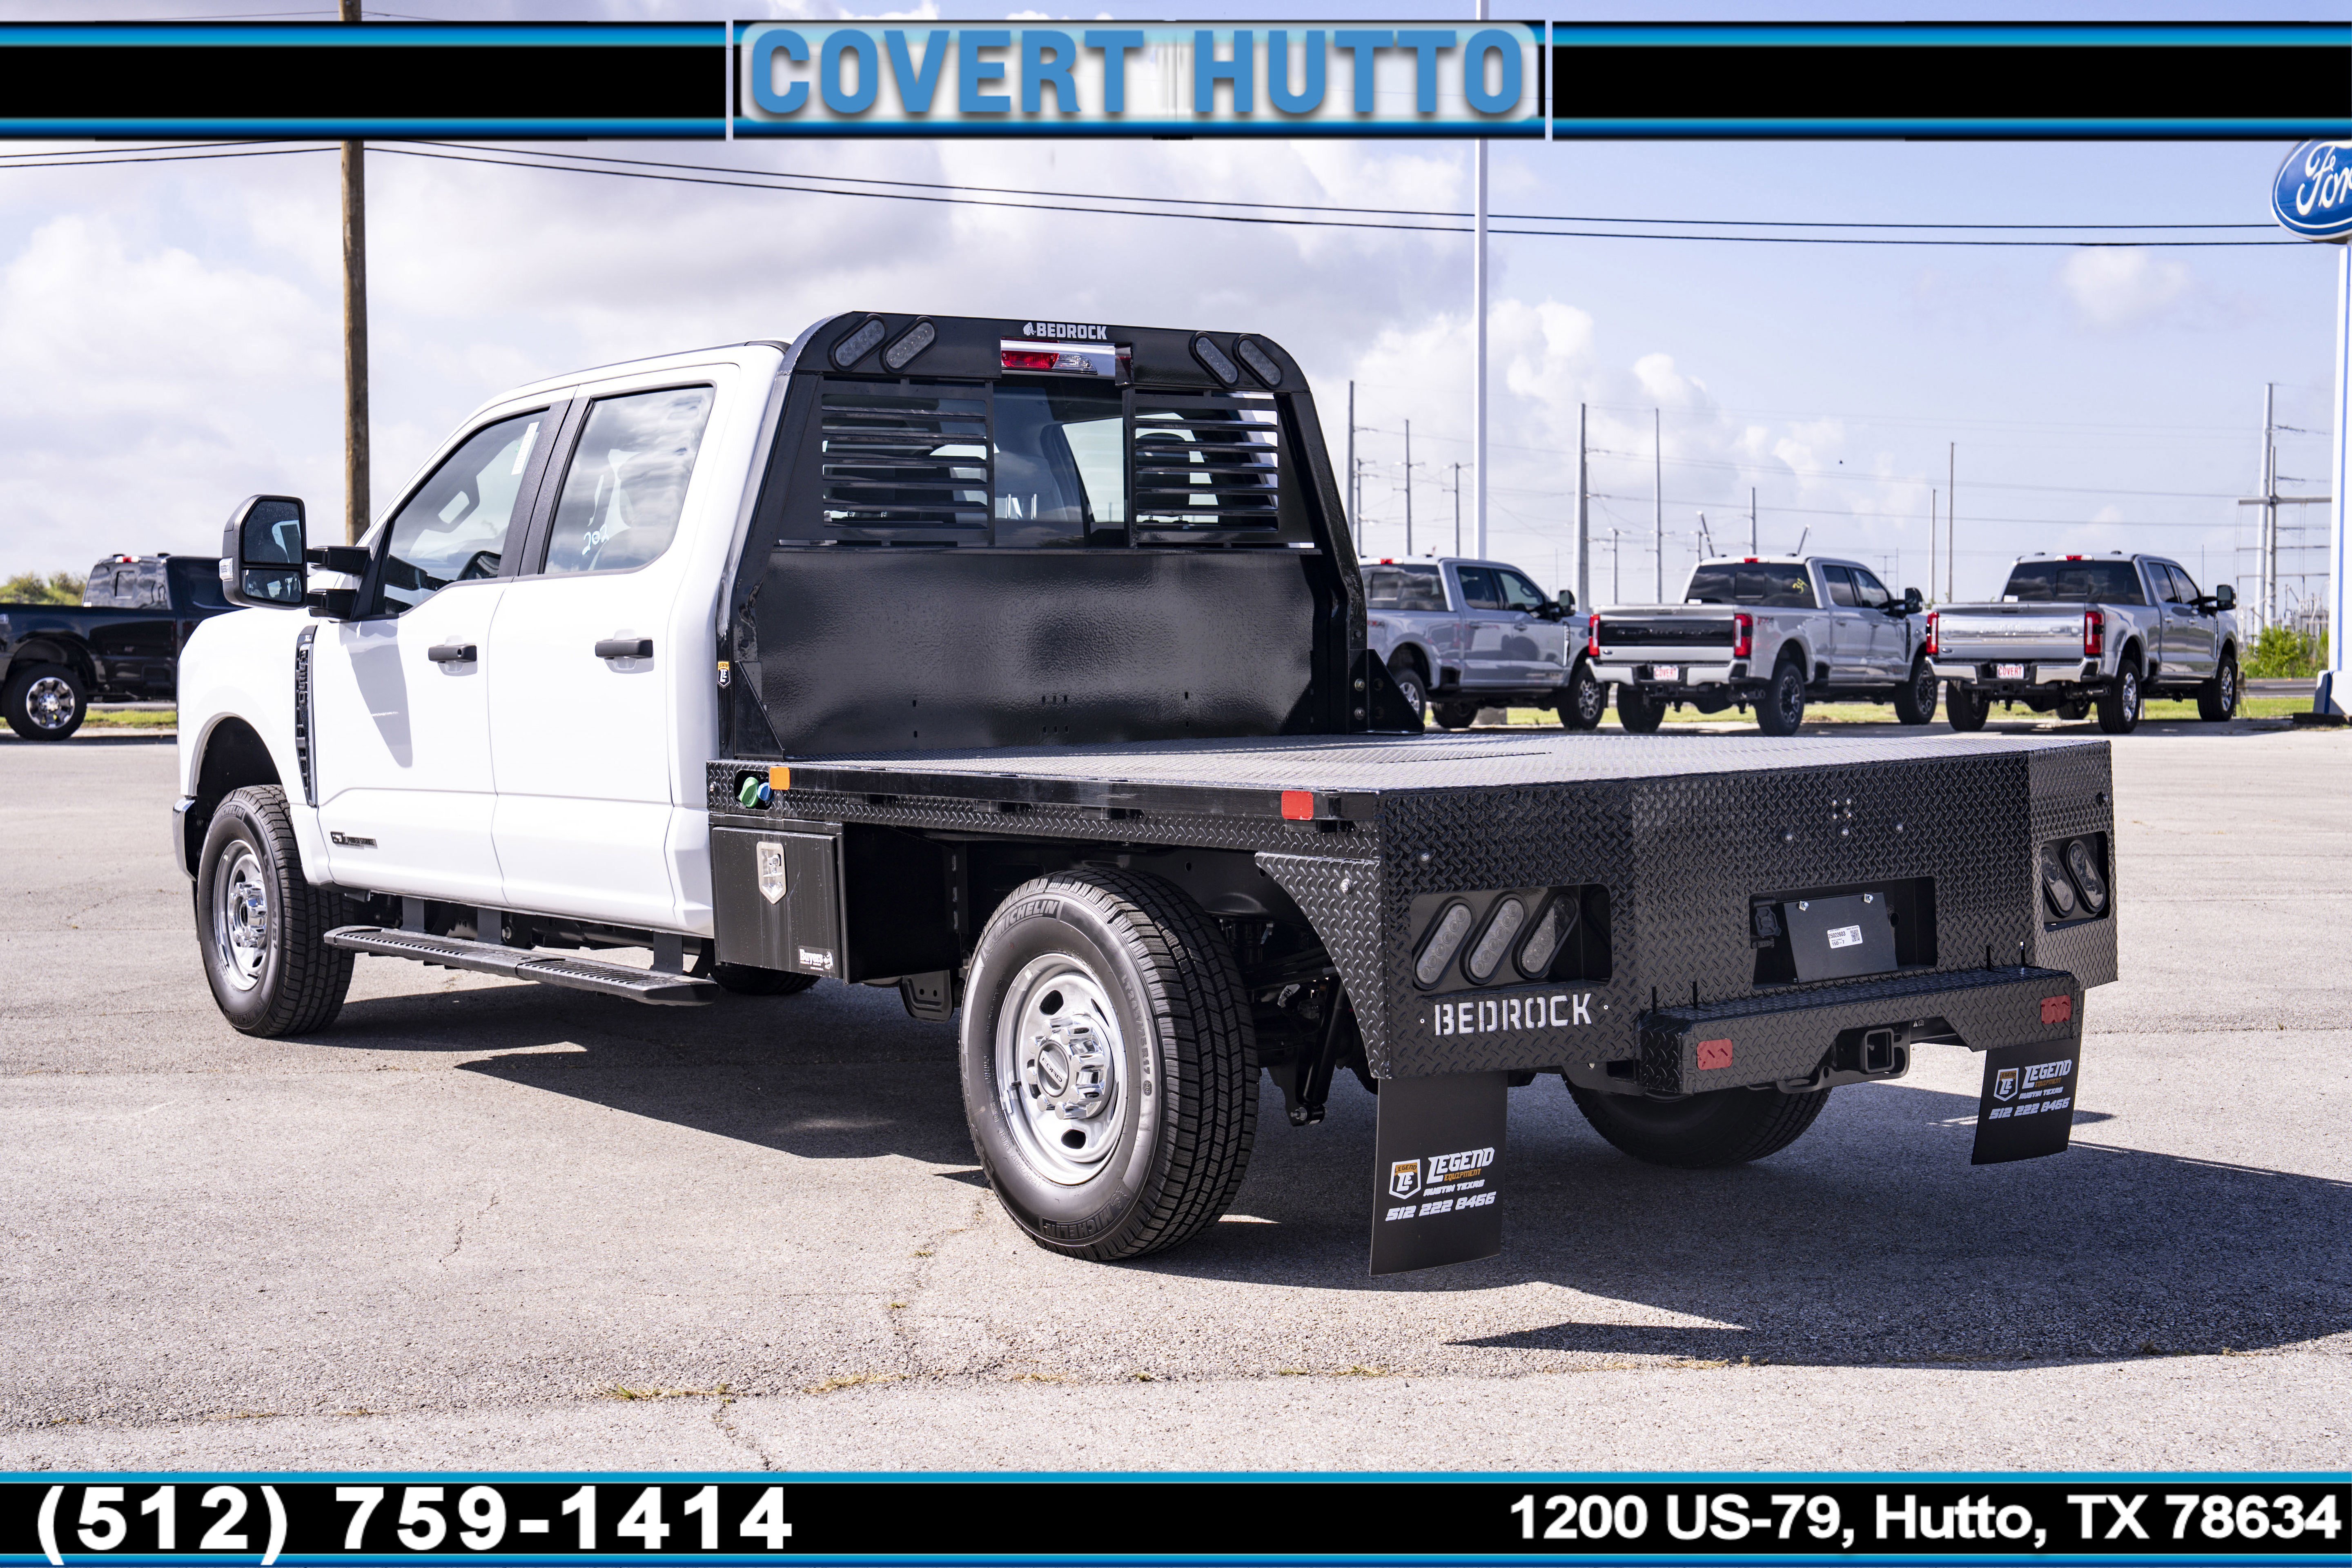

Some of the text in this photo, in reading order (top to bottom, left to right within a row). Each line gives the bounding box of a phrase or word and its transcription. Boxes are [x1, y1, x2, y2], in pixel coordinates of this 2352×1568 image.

[2296, 141, 2352, 216] For
[1036, 322, 1107, 340] BEDROCK
[1999, 666, 2022, 676] COVERT
[991, 900, 1060, 942] MICHELIN
[800, 949, 823, 964] Buyers
[1434, 993, 1592, 1036] BEDROCK
[1042, 1057, 1062, 1082] FORD
[2022, 1059, 2072, 1089] LEGEND
[2018, 1087, 2064, 1100] AUSTIN TEXAS
[2035, 1077, 2062, 1088] EQUIPMENT
[1989, 1097, 2071, 1120] 512 222 8466
[1011, 1154, 1042, 1188] LT245/75R17
[1394, 1164, 1417, 1174] LEGEND
[1426, 1147, 1495, 1185] LEGEND
[1444, 1168, 1481, 1182] EQUIPMENT
[1423, 1179, 1485, 1197] AUSTIN TEXAS
[1385, 1191, 1497, 1222] 512 222 8466
[1044, 1205, 1115, 1240] MICHELIN
